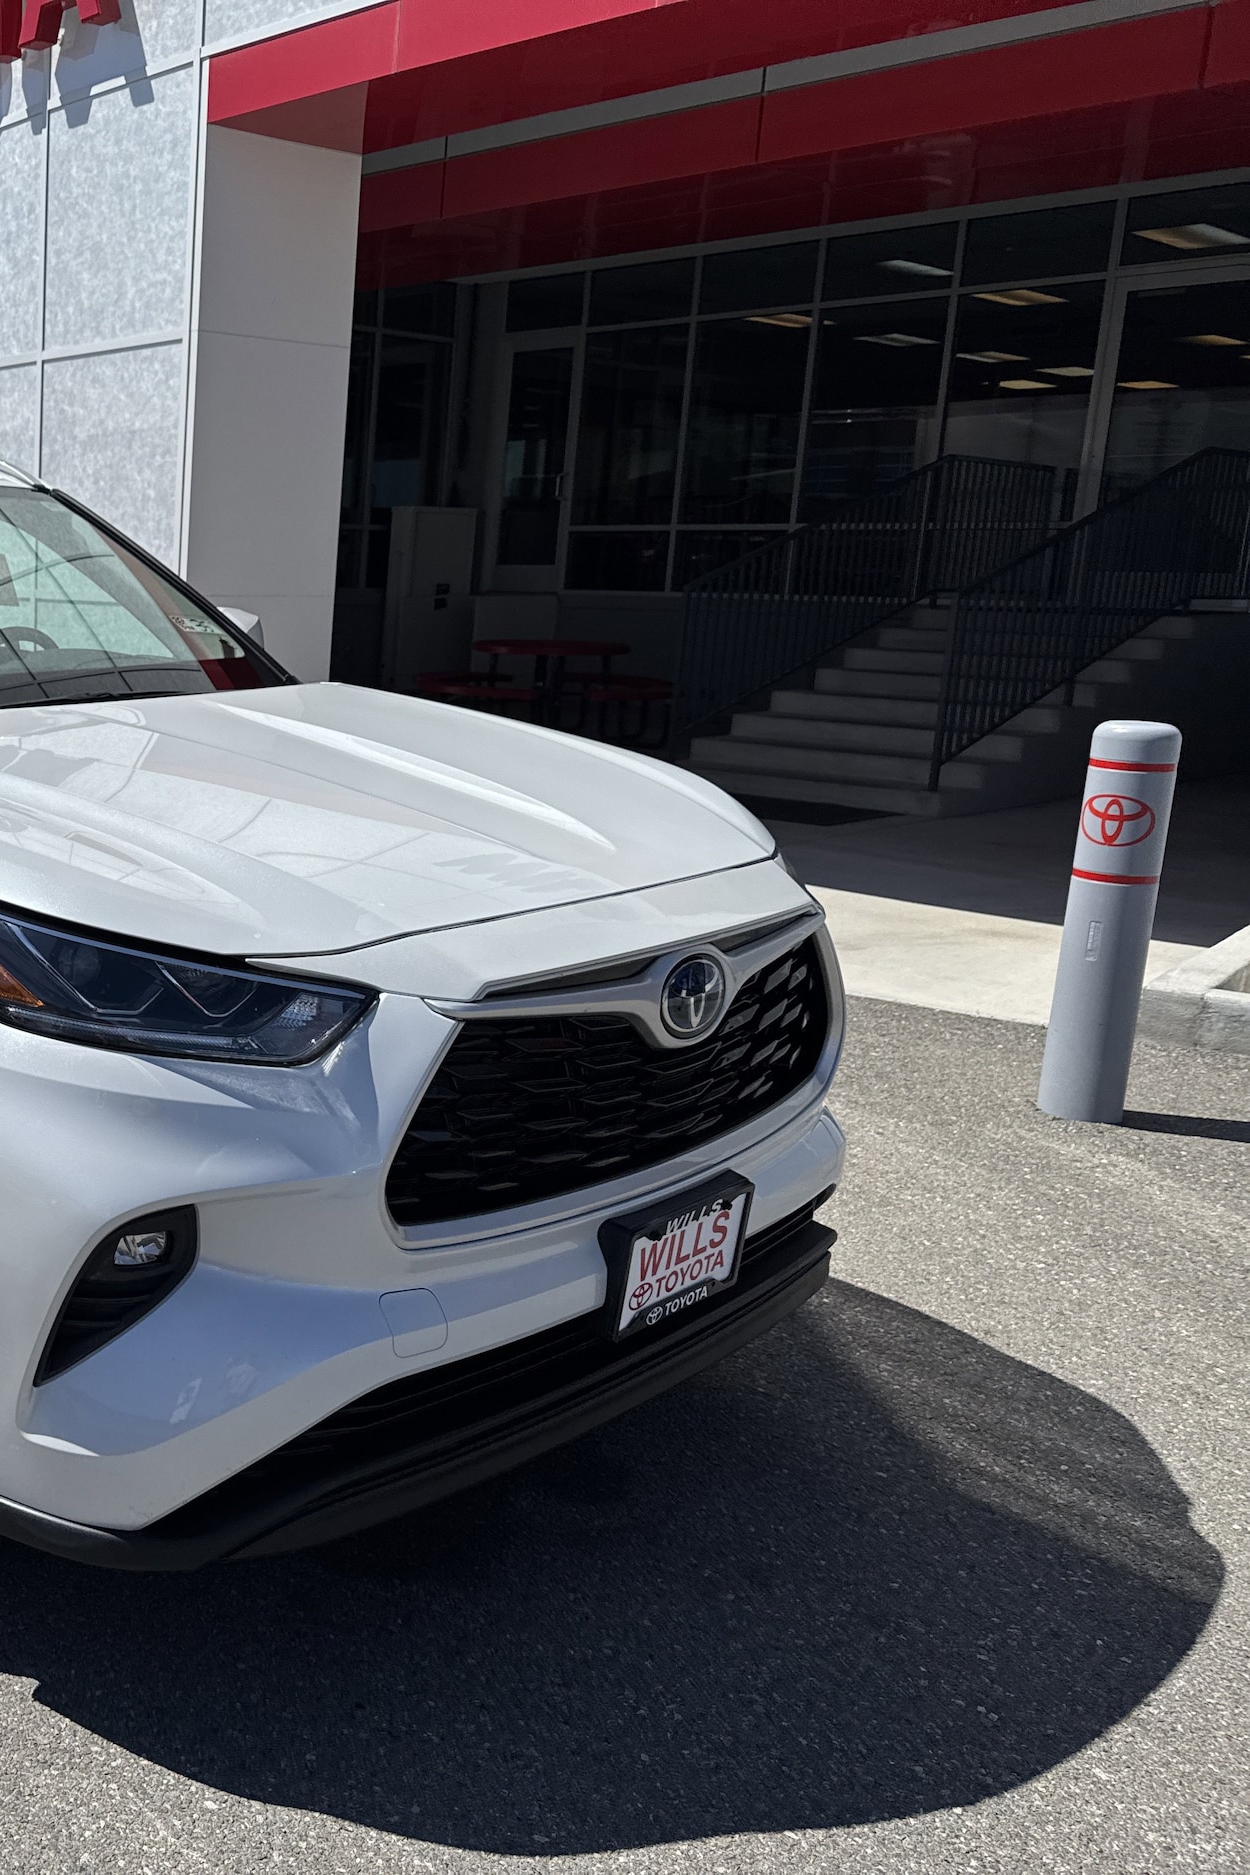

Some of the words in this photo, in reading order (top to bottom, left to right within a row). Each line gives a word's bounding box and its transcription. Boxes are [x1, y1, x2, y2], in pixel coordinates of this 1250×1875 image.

[640, 1211, 730, 1282] WILLS
[655, 1249, 724, 1298] TOYOTA
[665, 1285, 708, 1316] TOYOTA
